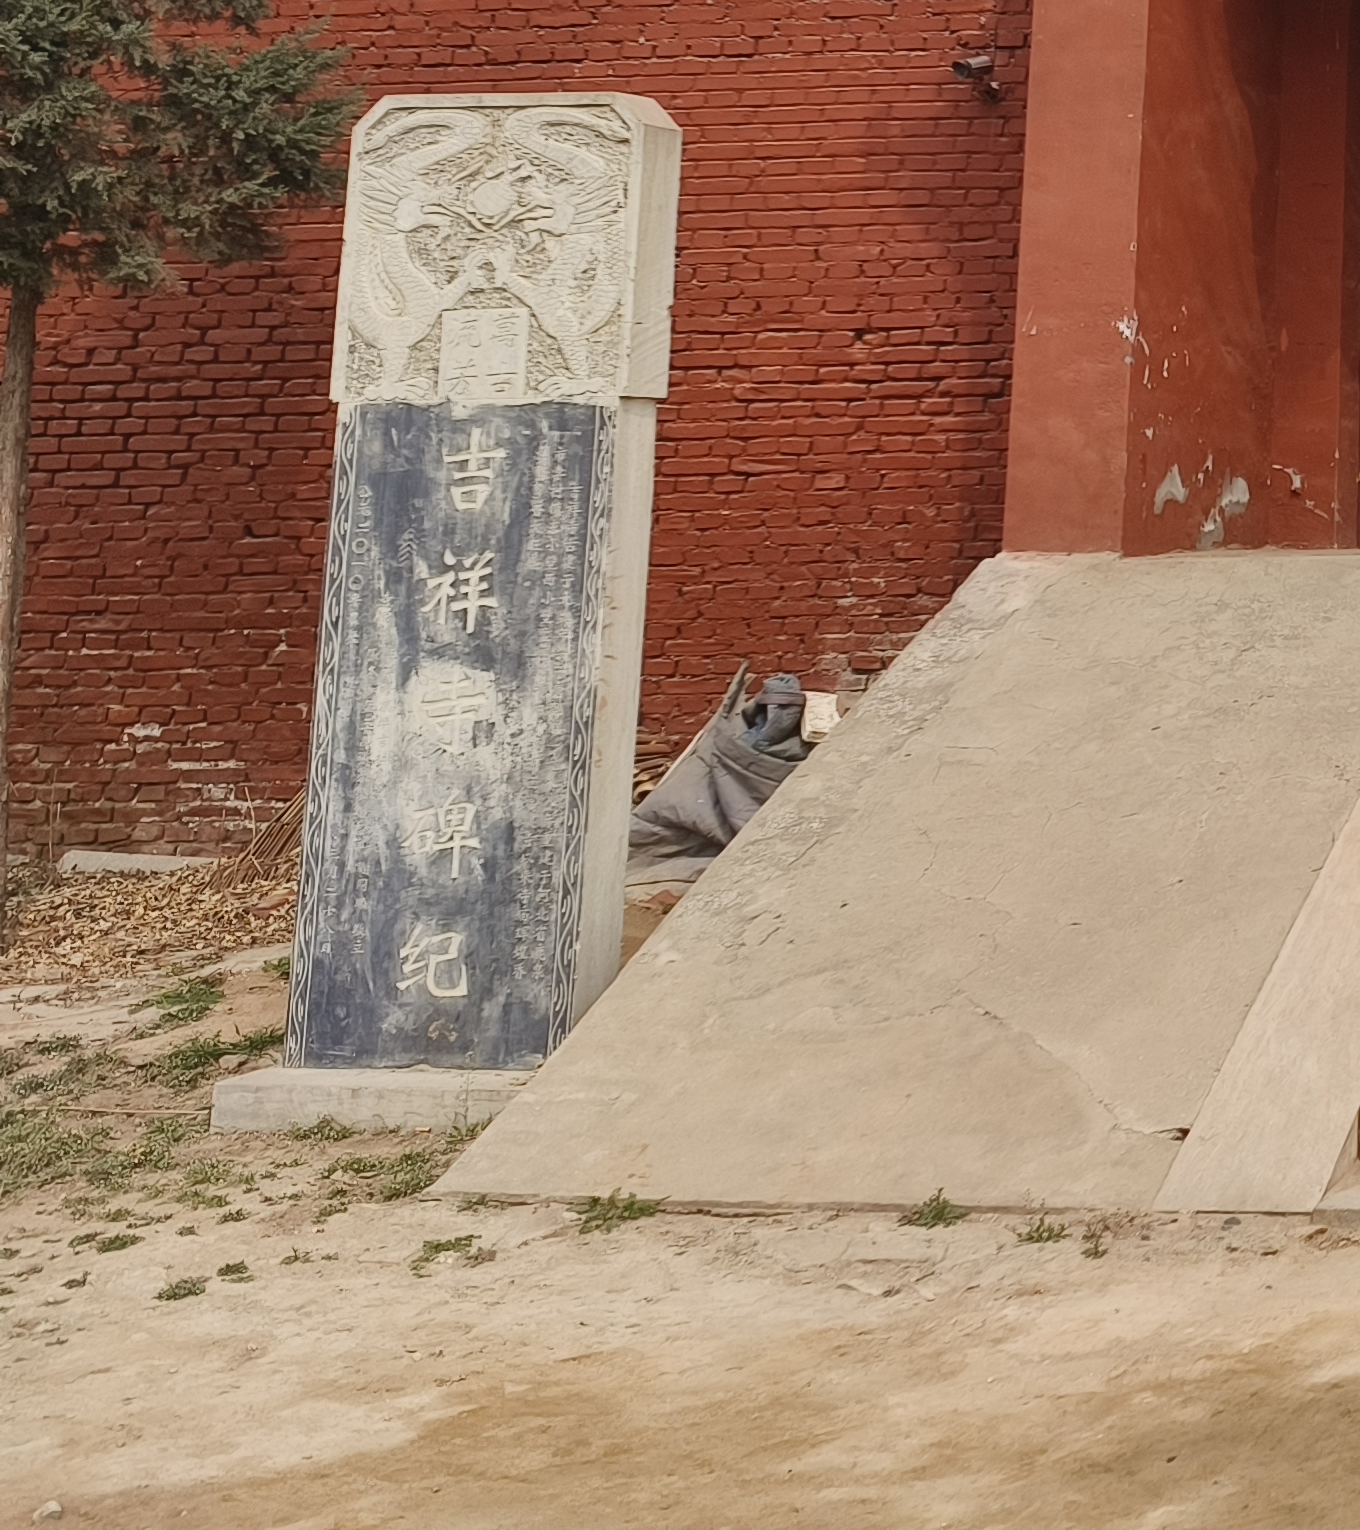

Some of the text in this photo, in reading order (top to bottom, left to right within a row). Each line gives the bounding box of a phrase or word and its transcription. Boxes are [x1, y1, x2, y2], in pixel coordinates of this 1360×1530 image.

[395, 425, 507, 998] 吉祥寺碑纪
